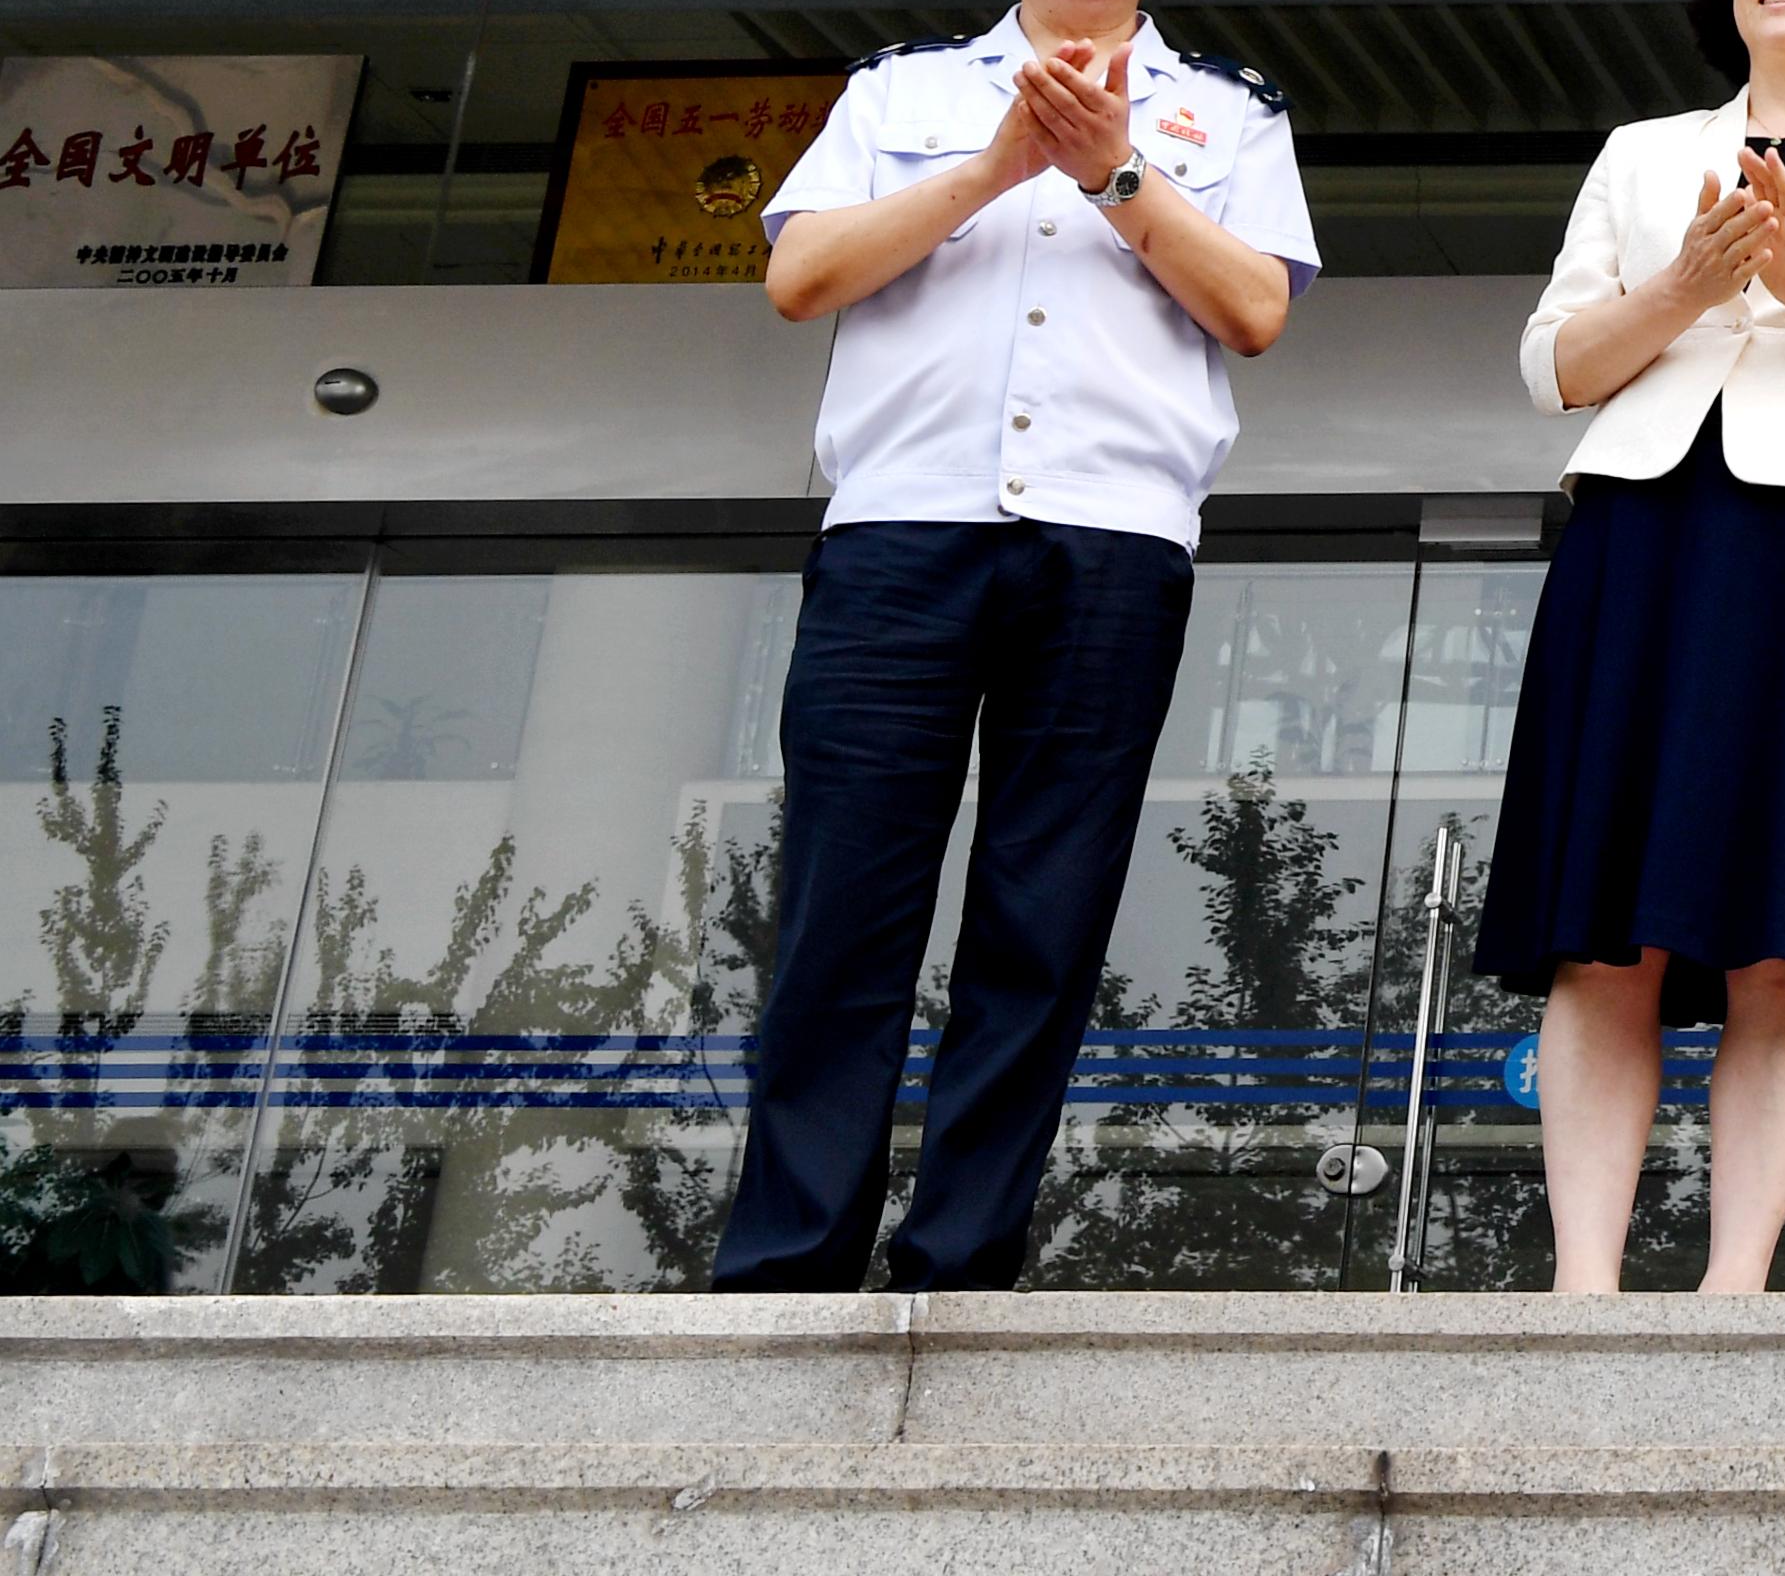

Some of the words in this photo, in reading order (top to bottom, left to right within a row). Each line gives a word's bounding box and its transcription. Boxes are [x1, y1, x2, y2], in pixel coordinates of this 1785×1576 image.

[0, 124, 321, 191] 全国文明单位
[669, 265, 757, 278] 2014年4月
